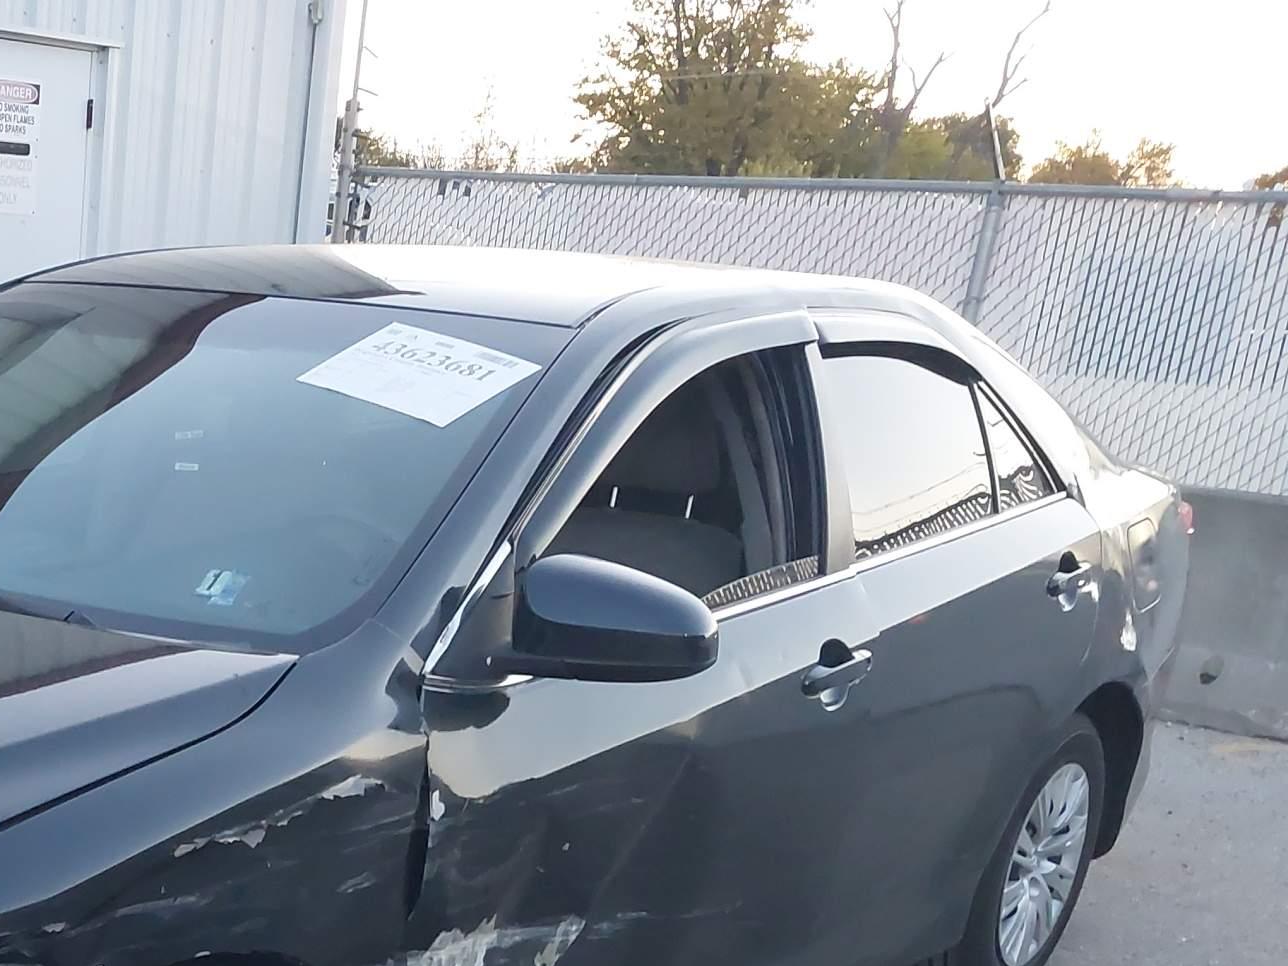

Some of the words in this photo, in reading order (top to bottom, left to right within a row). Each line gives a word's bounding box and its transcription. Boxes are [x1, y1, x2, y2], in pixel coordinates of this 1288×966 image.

[4, 103, 29, 114] SMOKING
[13, 114, 35, 125] FLAMES
[4, 124, 26, 134] SPARKS
[373, 340, 496, 381] 43623681
